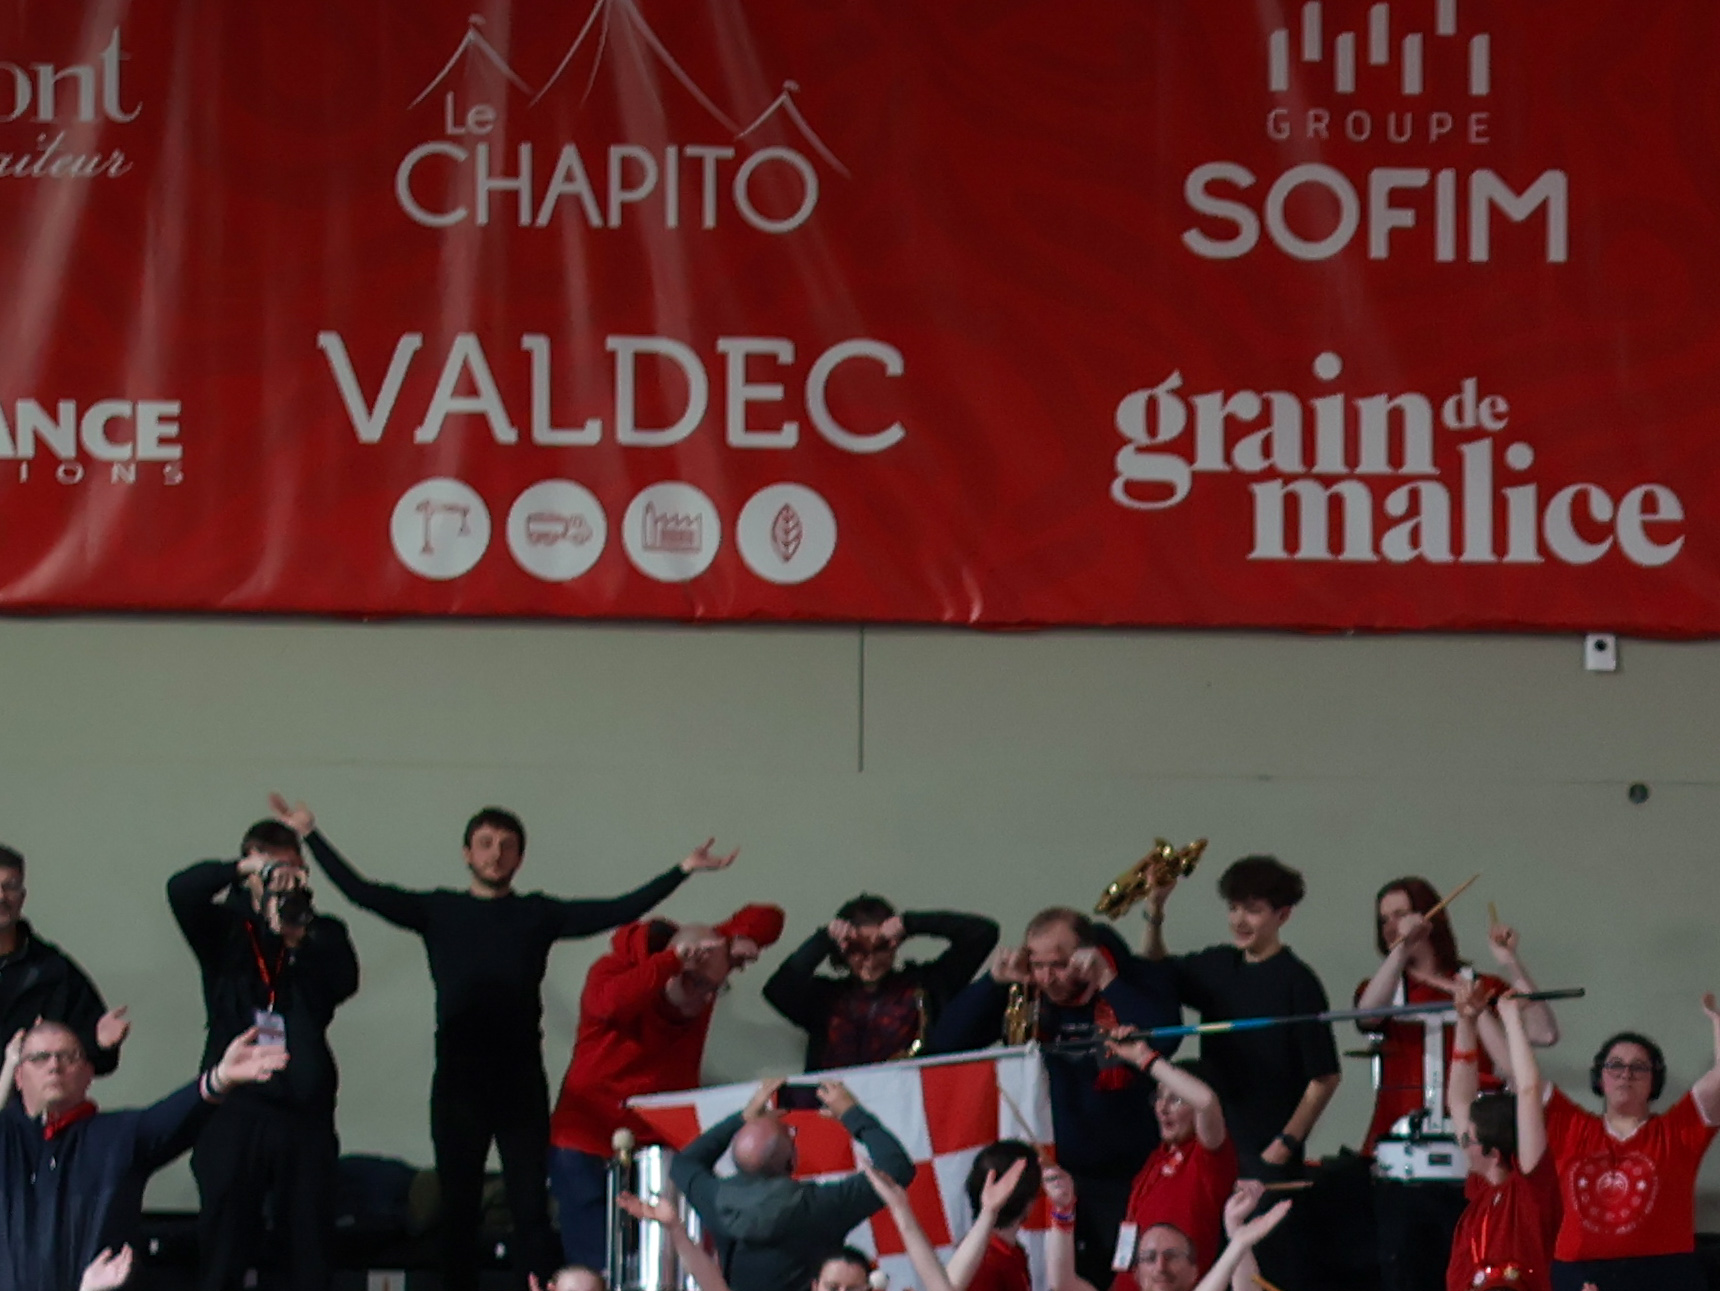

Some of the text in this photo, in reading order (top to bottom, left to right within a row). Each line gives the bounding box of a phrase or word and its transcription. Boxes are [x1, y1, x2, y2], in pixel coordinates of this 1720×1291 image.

[444, 91, 497, 136] Le
[1267, 109, 1492, 144] GROUPE
[396, 142, 818, 233] CHAPITO
[1182, 161, 1568, 263] SOFIM
[318, 330, 904, 455] VALDEC
[1110, 351, 1510, 510] grain de
[1247, 440, 1686, 567] malice
